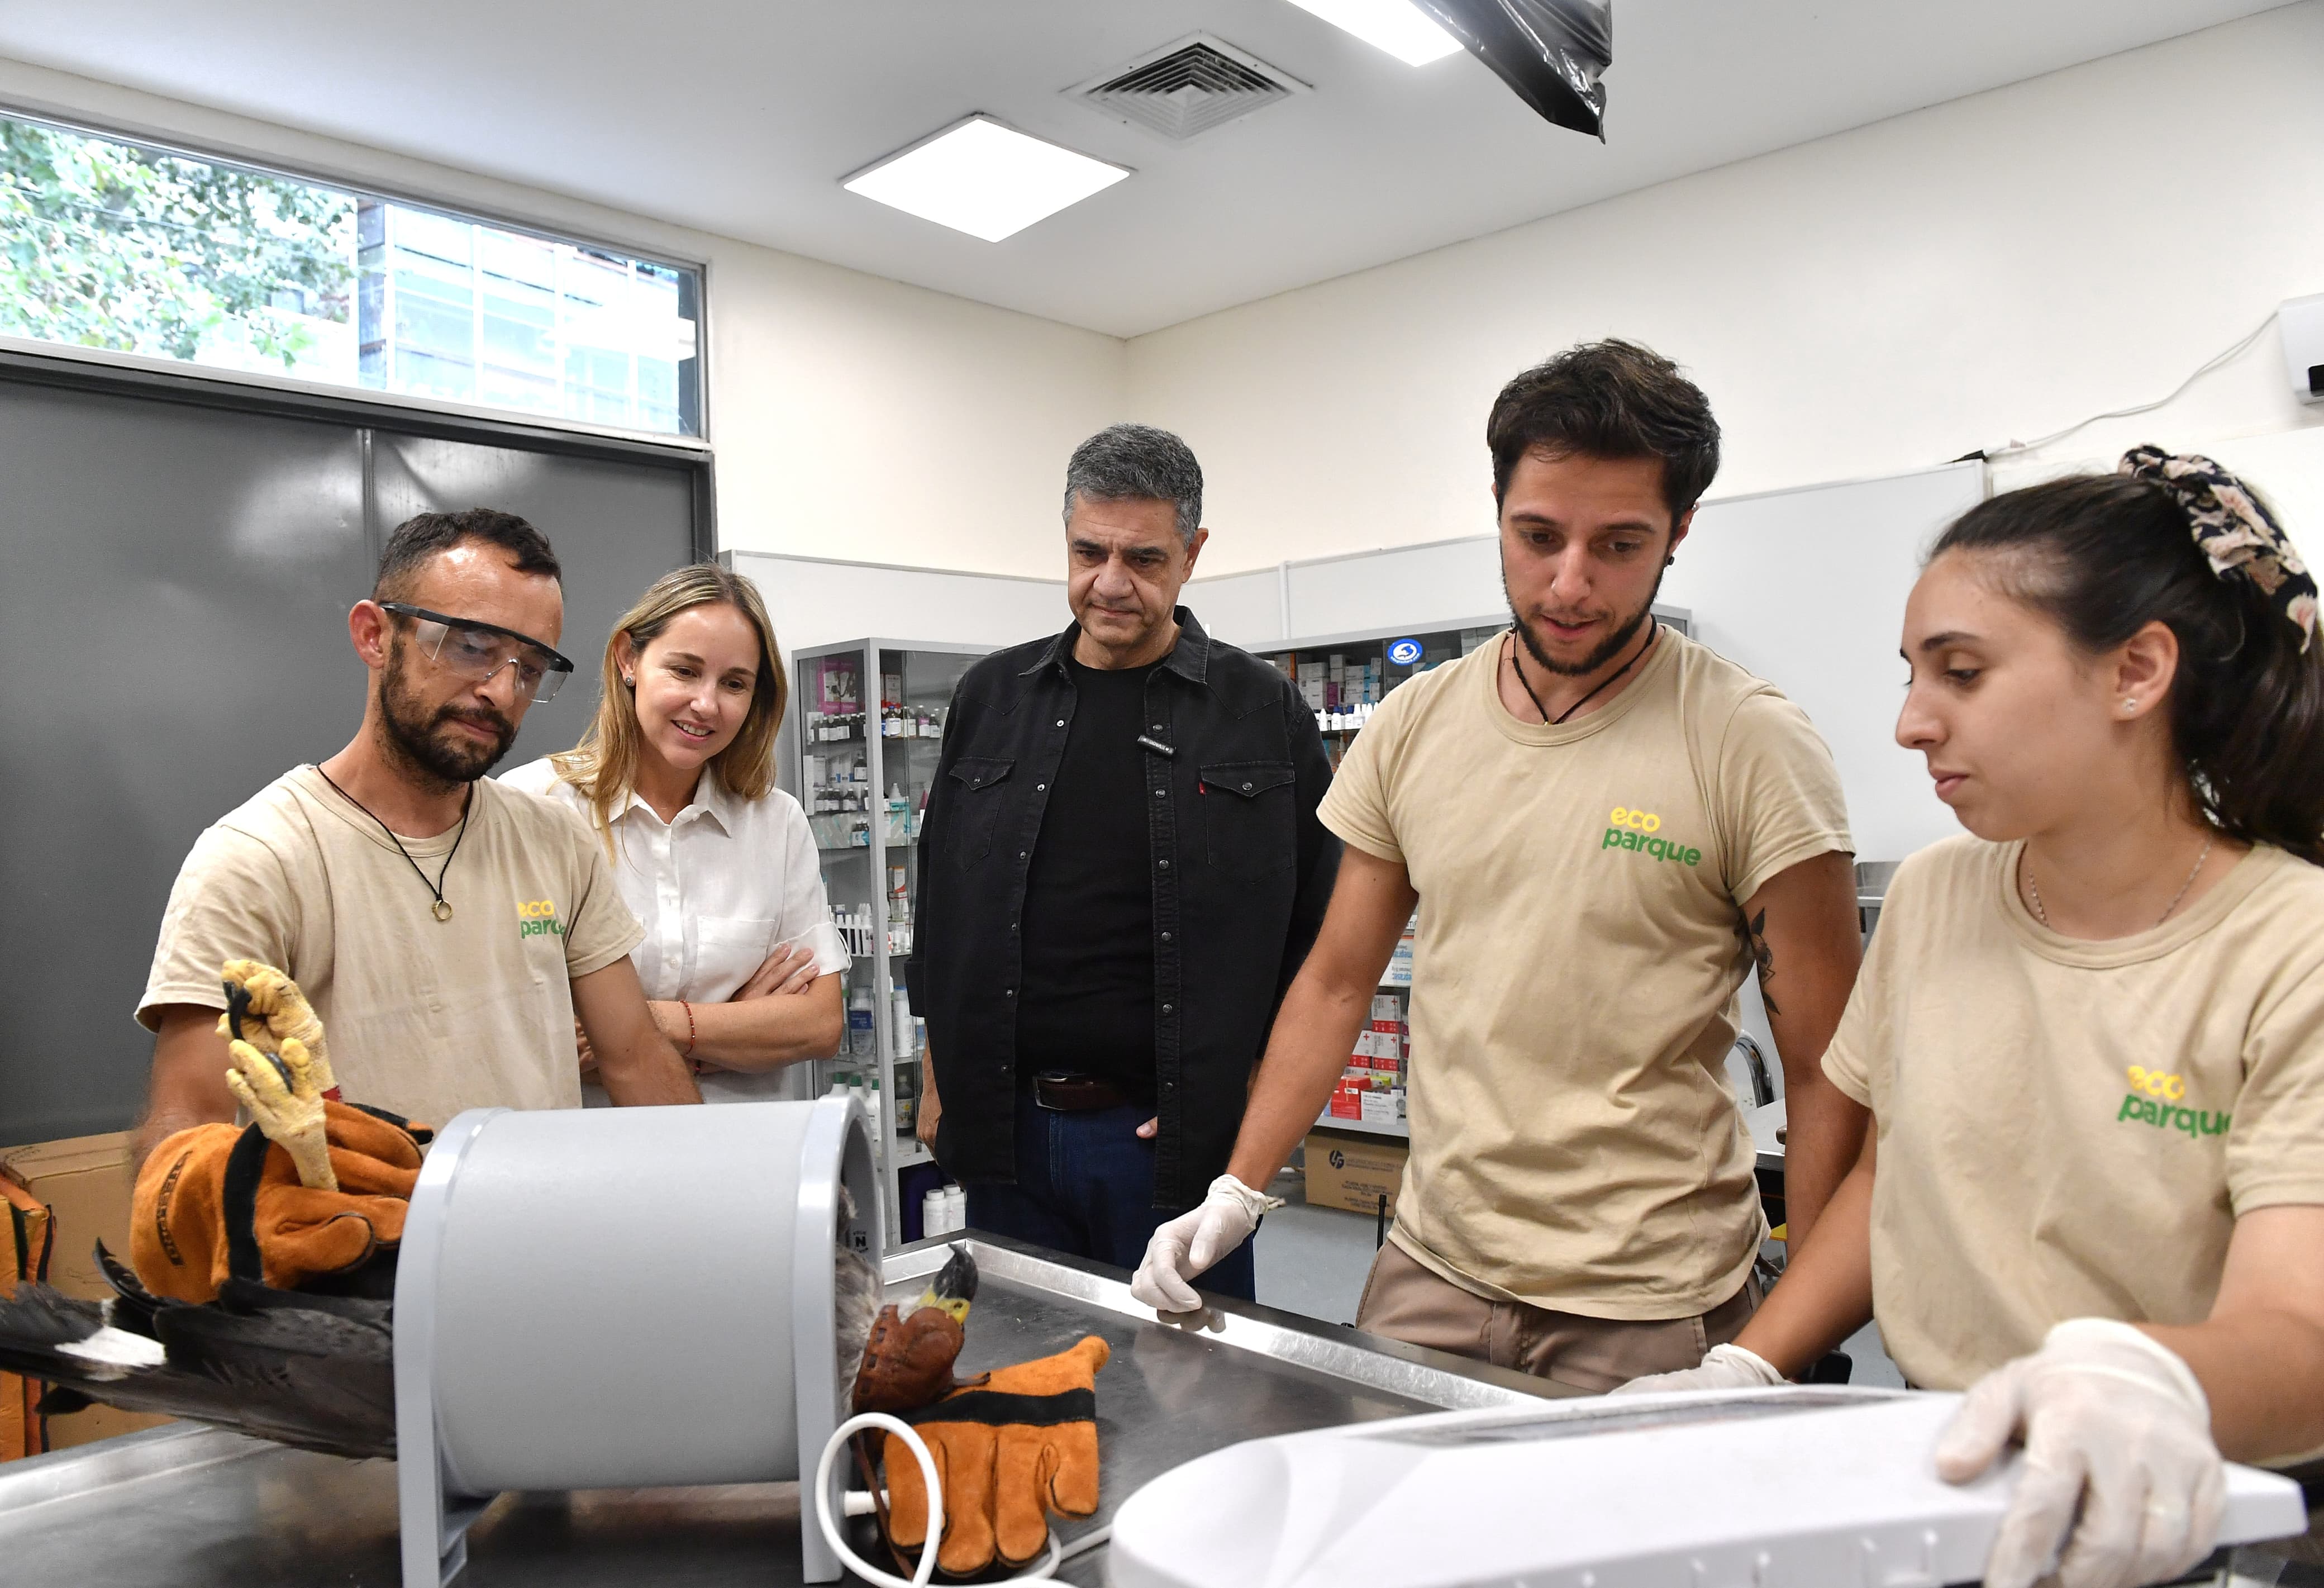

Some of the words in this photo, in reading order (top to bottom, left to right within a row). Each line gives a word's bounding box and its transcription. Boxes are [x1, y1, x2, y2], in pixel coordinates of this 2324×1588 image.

[1611, 807, 1661, 832] eco
[1602, 828, 1702, 866] parque
[517, 900, 555, 917] eco
[2127, 1065, 2185, 1100] eco
